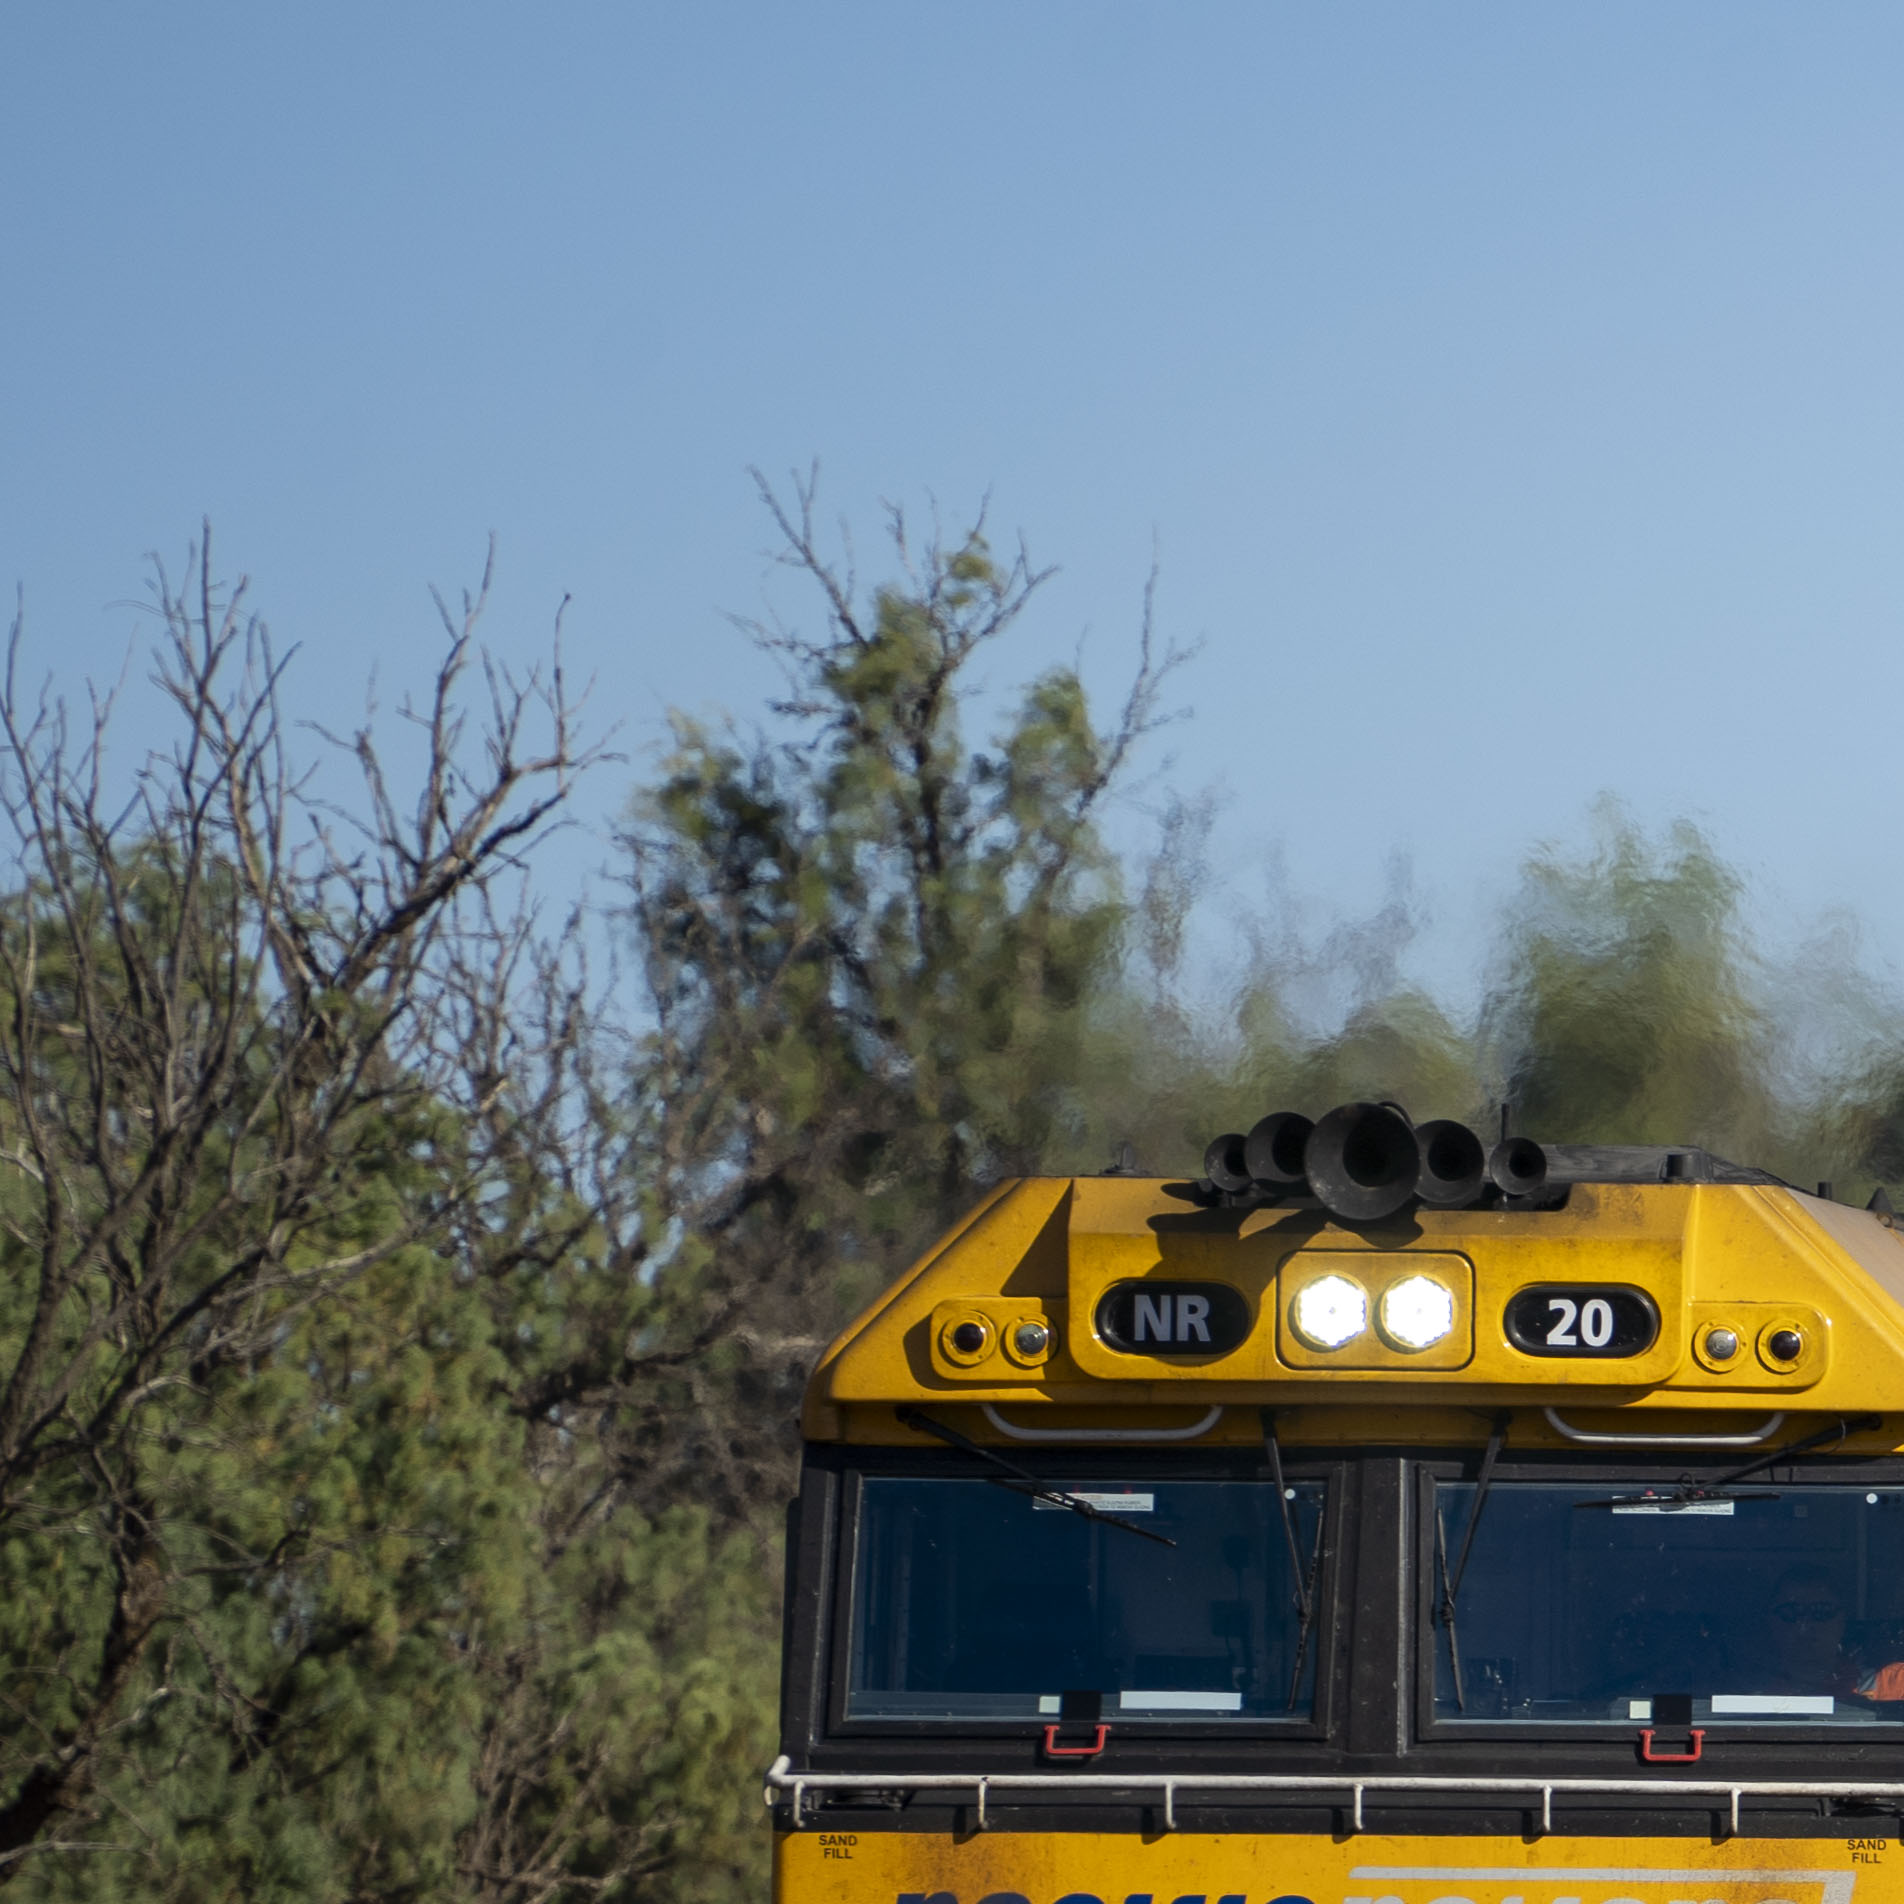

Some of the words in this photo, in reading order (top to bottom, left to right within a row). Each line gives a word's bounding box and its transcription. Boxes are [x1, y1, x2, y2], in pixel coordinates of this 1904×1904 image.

[1132, 1294, 1211, 1342] NR
[1546, 1299, 1614, 1346] 20
[818, 1834, 858, 1846] SAND
[1847, 1839, 1887, 1850] SAND
[824, 1848, 854, 1859] FILL
[1852, 1852, 1882, 1864] FILL
